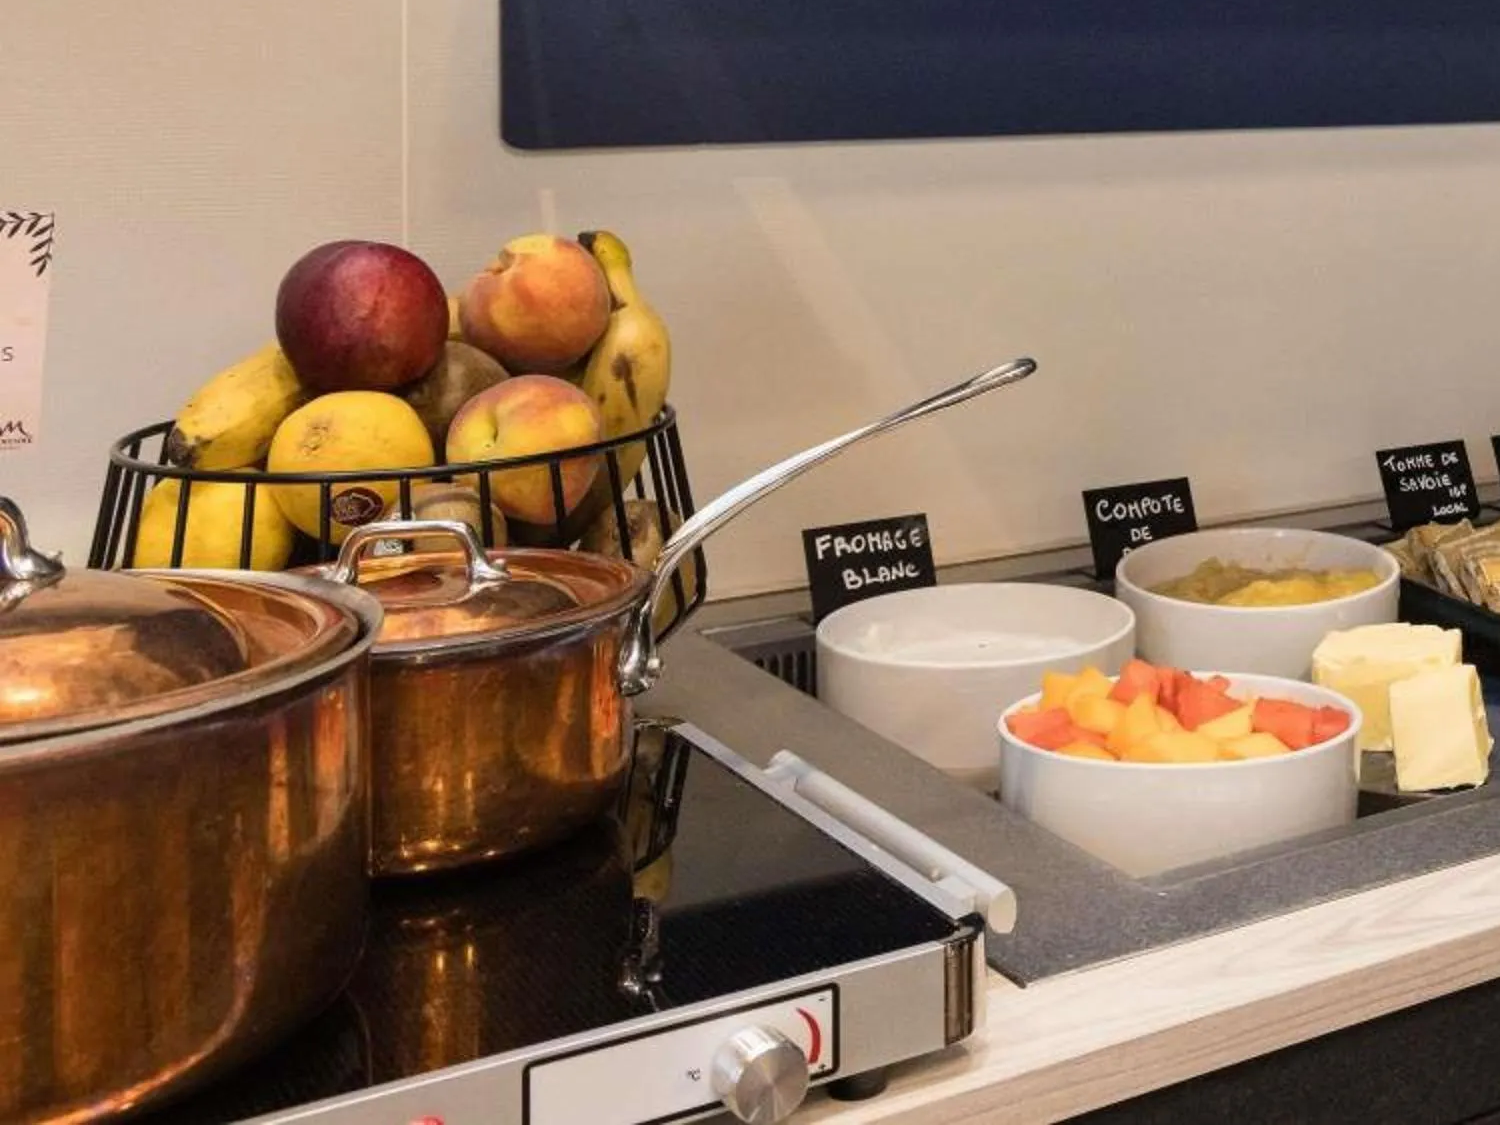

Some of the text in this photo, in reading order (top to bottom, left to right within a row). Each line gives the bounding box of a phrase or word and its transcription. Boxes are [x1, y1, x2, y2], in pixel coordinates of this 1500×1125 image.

[1383, 454, 1435, 472] TOMME
[1095, 494, 1185, 522] COMPOTE
[814, 527, 924, 560] FROMAGE
[1130, 525, 1153, 542] DE
[842, 561, 920, 590] BLANC
